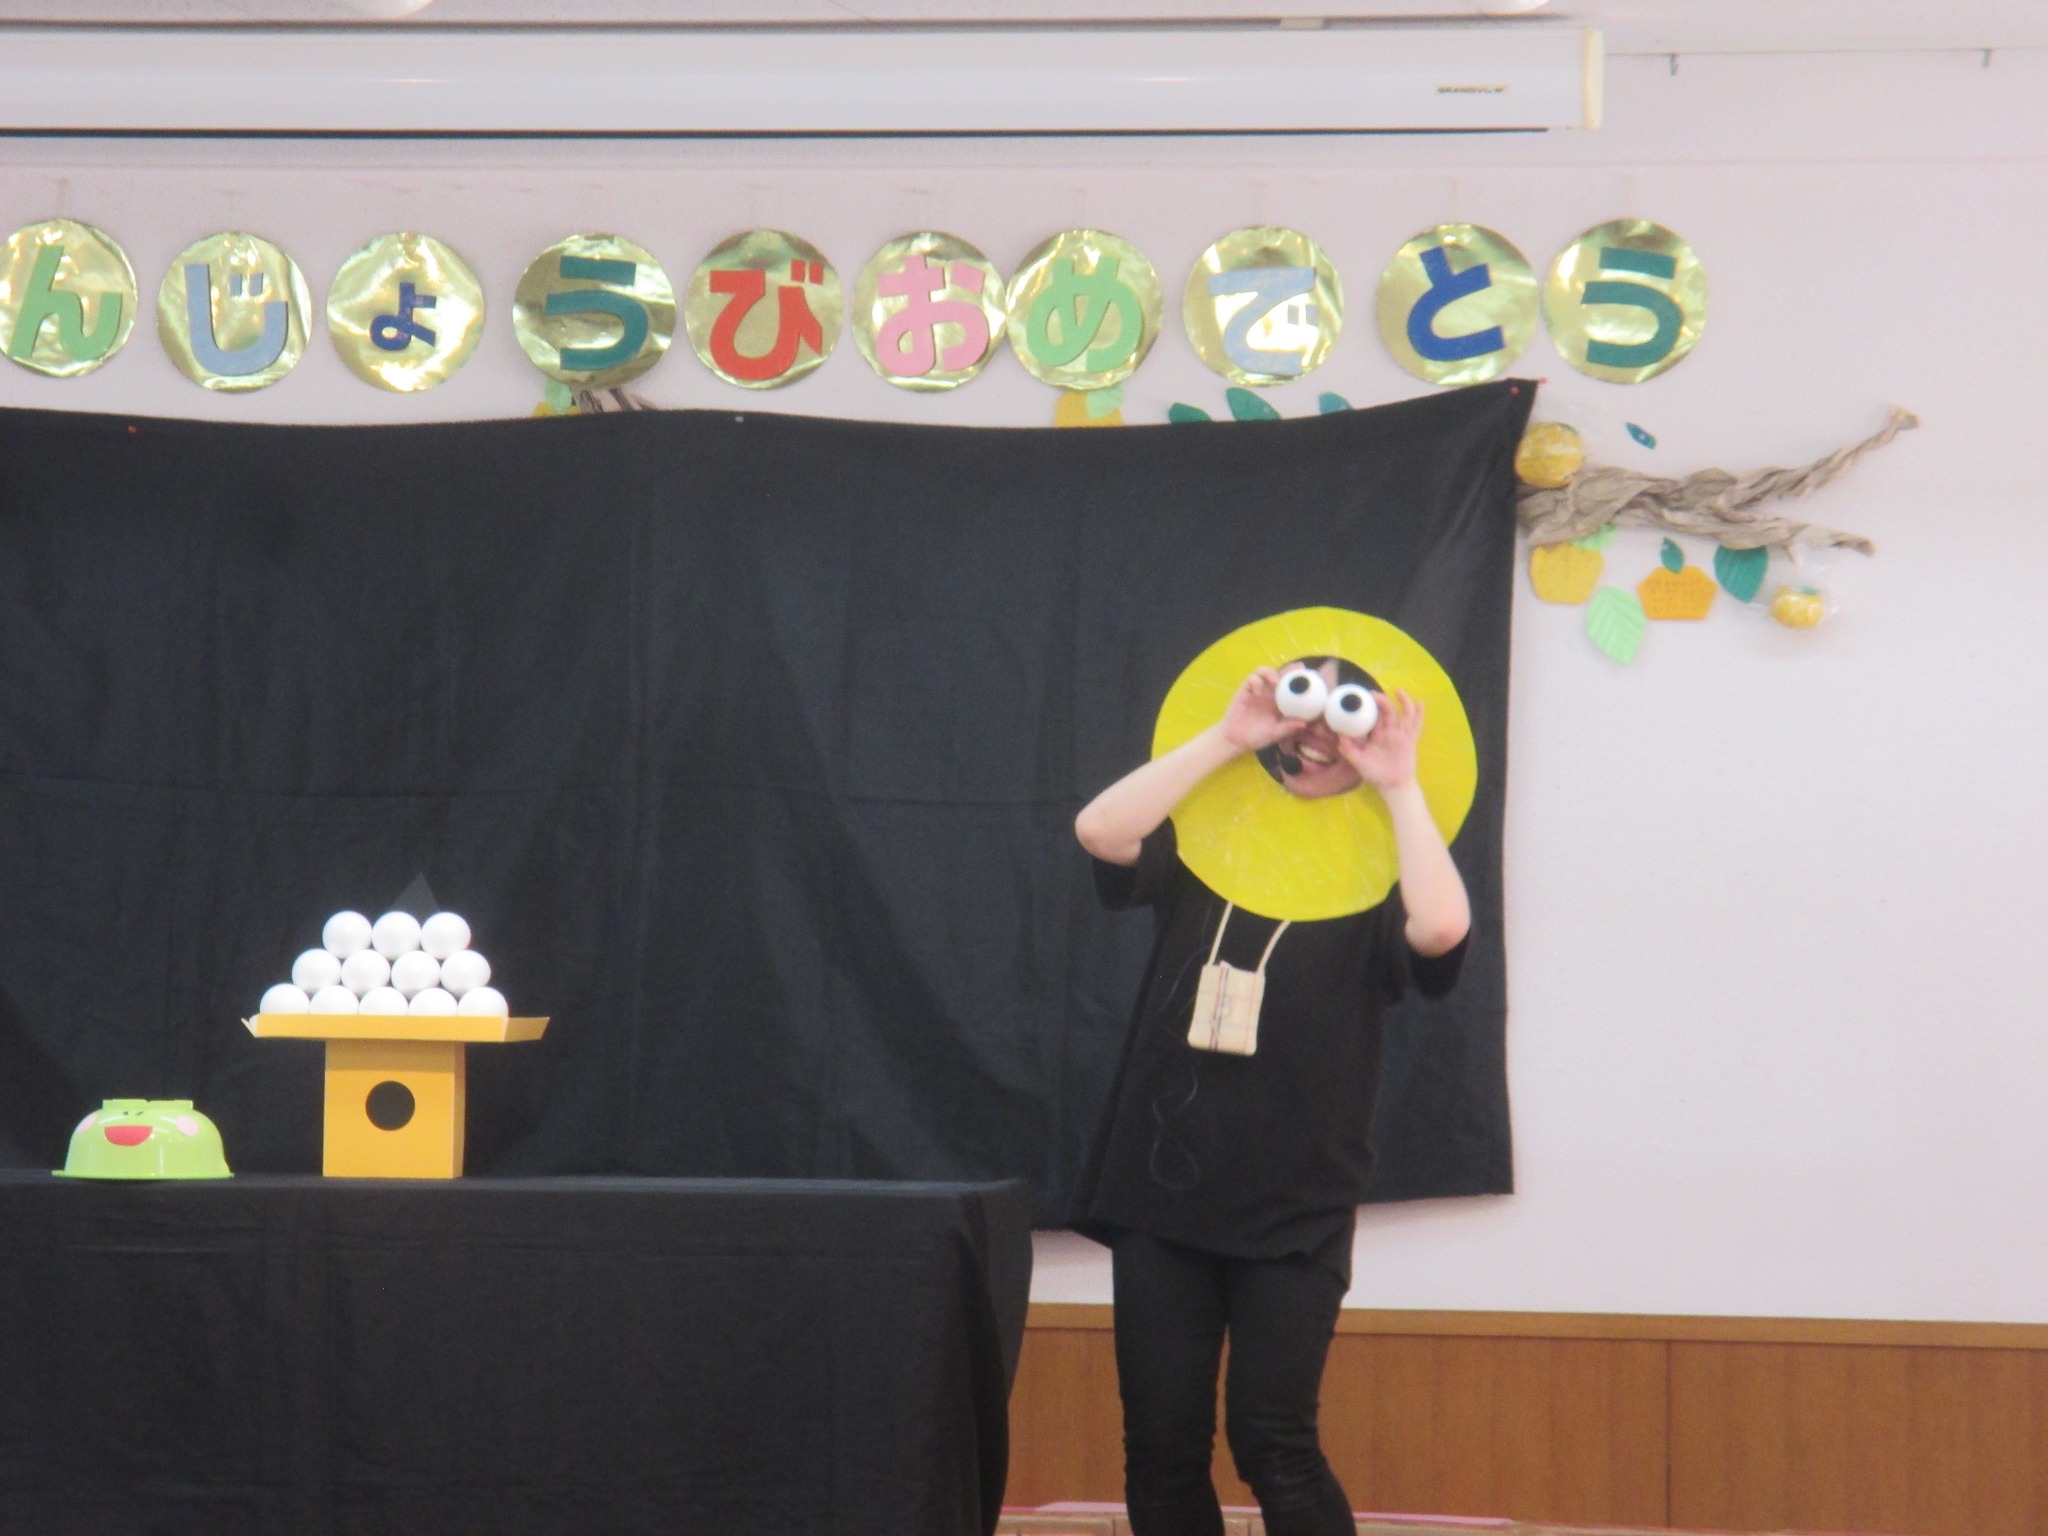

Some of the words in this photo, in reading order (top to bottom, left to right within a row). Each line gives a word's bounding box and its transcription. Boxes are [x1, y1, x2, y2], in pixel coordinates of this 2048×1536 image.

[10, 244, 1685, 380] んじょうびおめでとう
